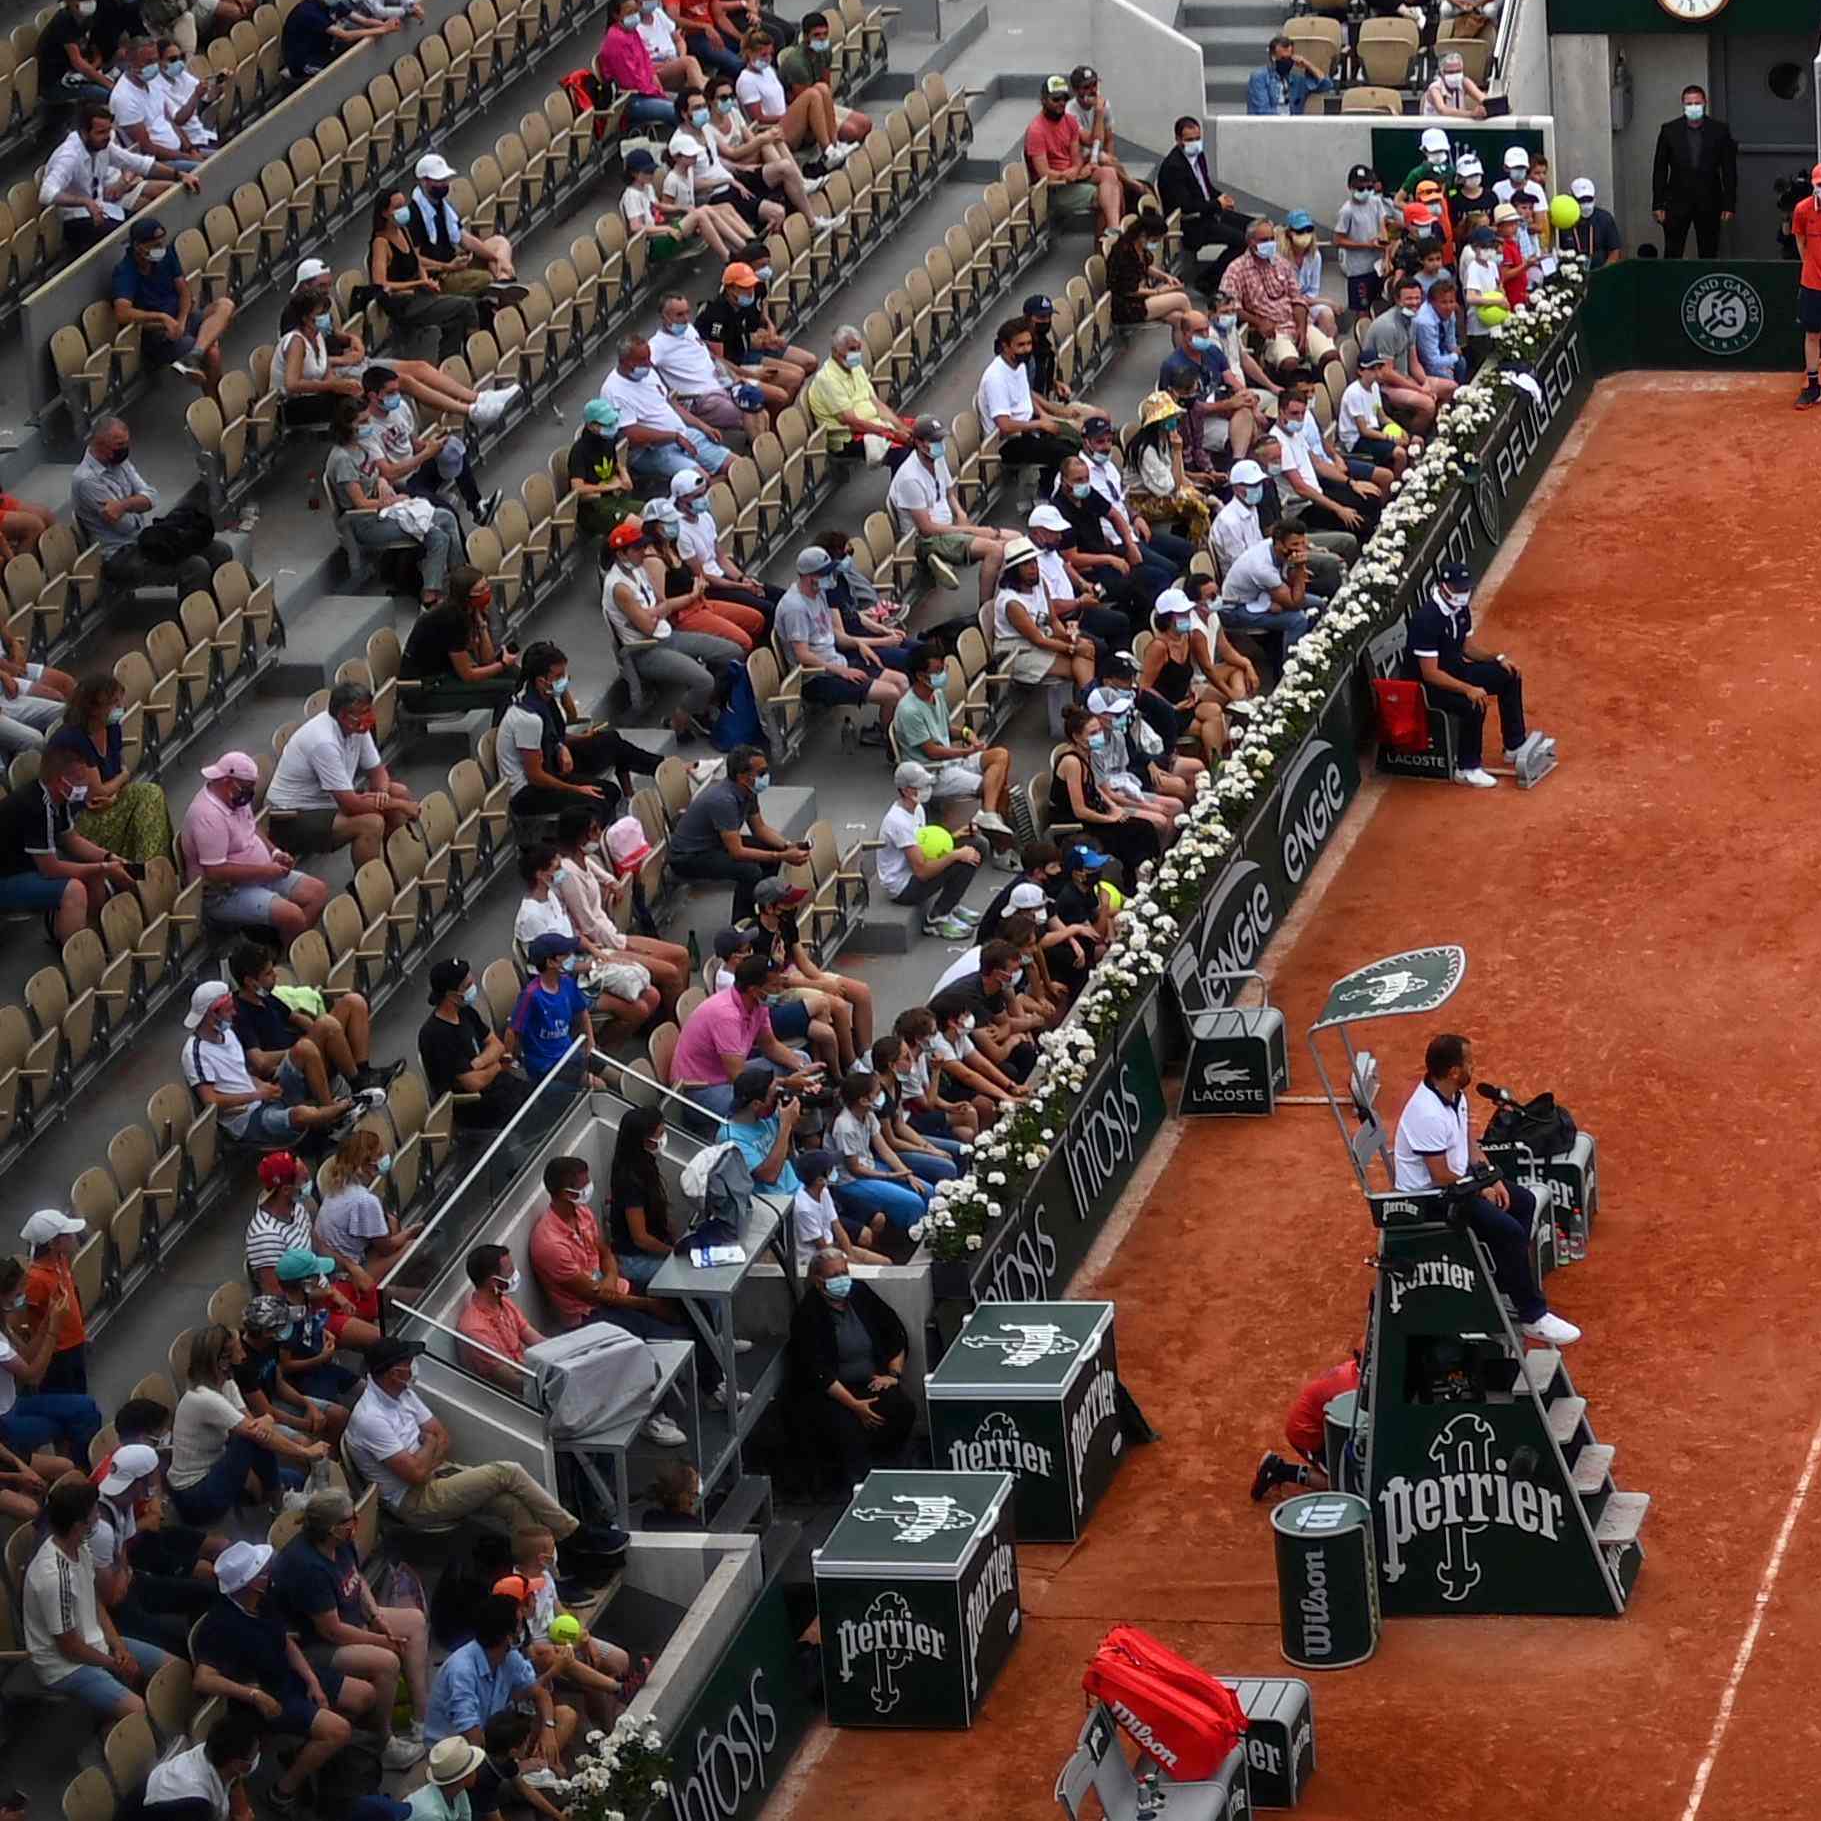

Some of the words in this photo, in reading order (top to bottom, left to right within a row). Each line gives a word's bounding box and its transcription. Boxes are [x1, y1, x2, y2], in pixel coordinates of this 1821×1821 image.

[1686, 279, 1719, 322] ROLAND
[1722, 279, 1759, 322] GARROS
[1497, 331, 1583, 497] PEUGEOT
[1386, 752, 1446, 768] LACOSTE
[1193, 1087, 1265, 1103] LACOSTE
[1063, 1063, 1142, 1220] Infosys
[1302, 1548, 1331, 1658] Wilson
[1111, 1700, 1179, 1769] Wilson
